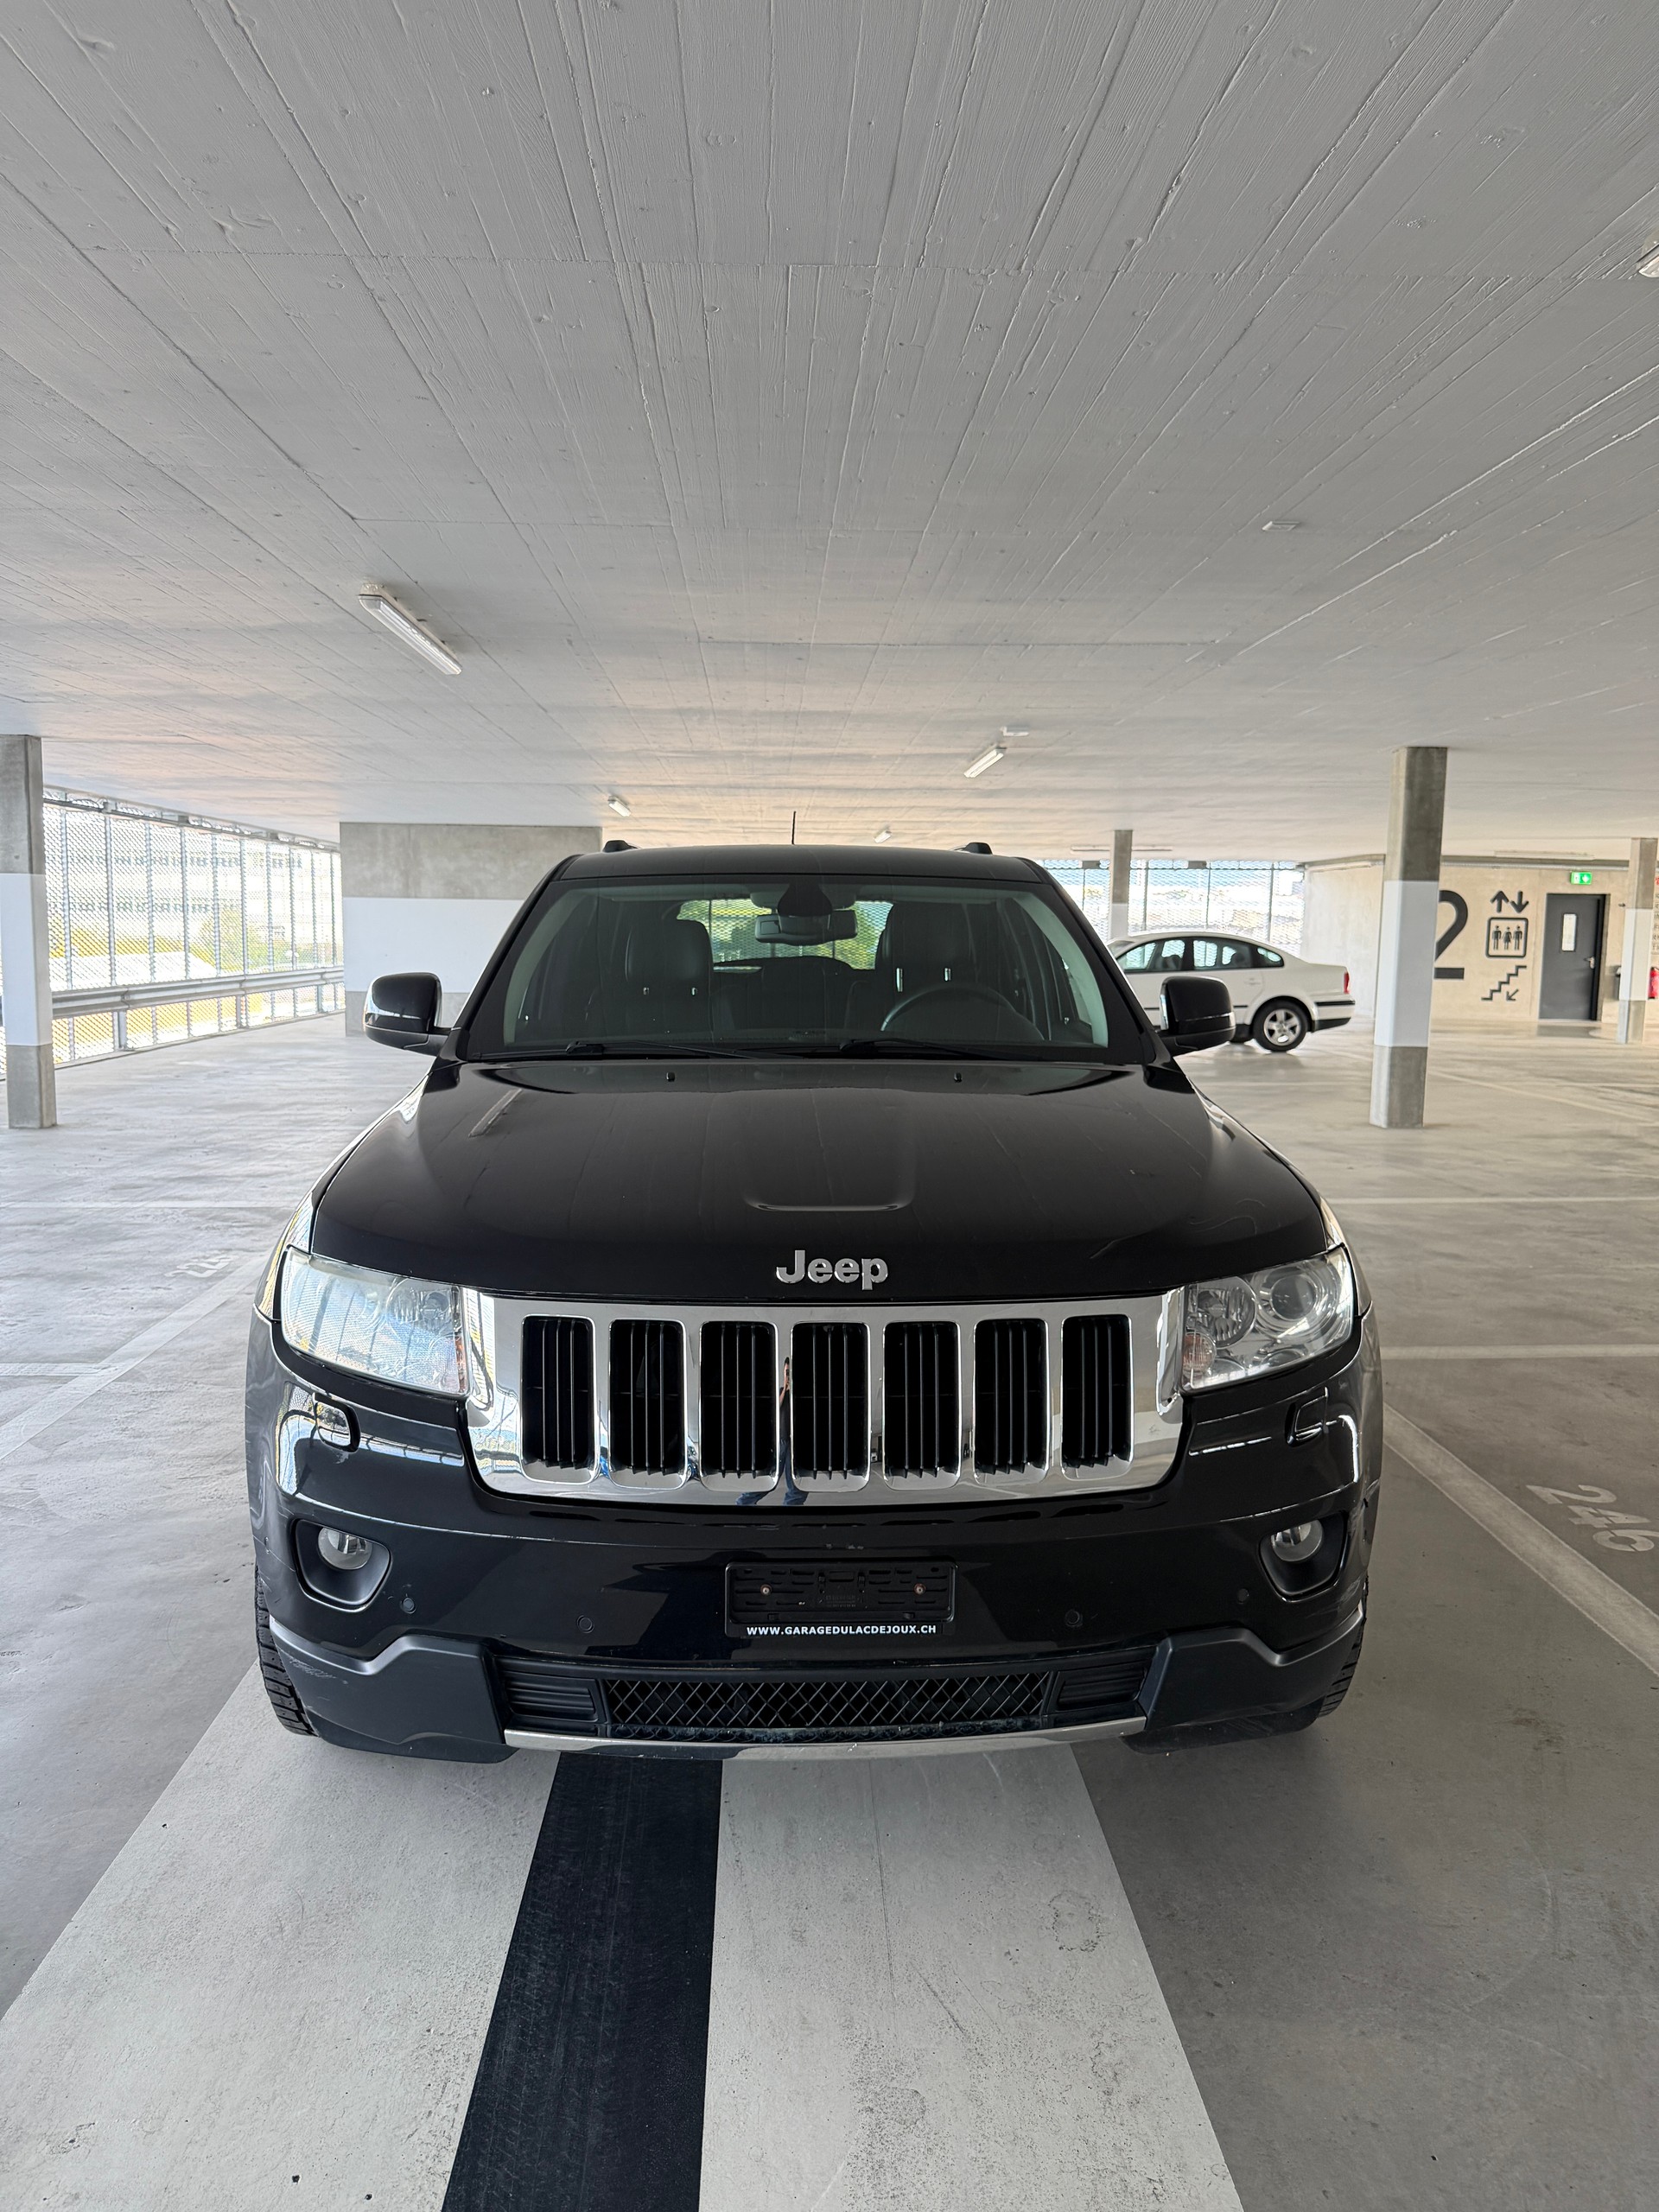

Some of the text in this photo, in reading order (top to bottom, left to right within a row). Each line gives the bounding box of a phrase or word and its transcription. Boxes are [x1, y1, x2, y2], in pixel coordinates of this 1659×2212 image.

[1434, 889, 1469, 980] 2
[776, 1249, 888, 1290] Jeep
[1526, 1484, 1659, 1552] 246
[747, 1624, 937, 1636] WWW.GARAGEDULACDEJOUX.CH
